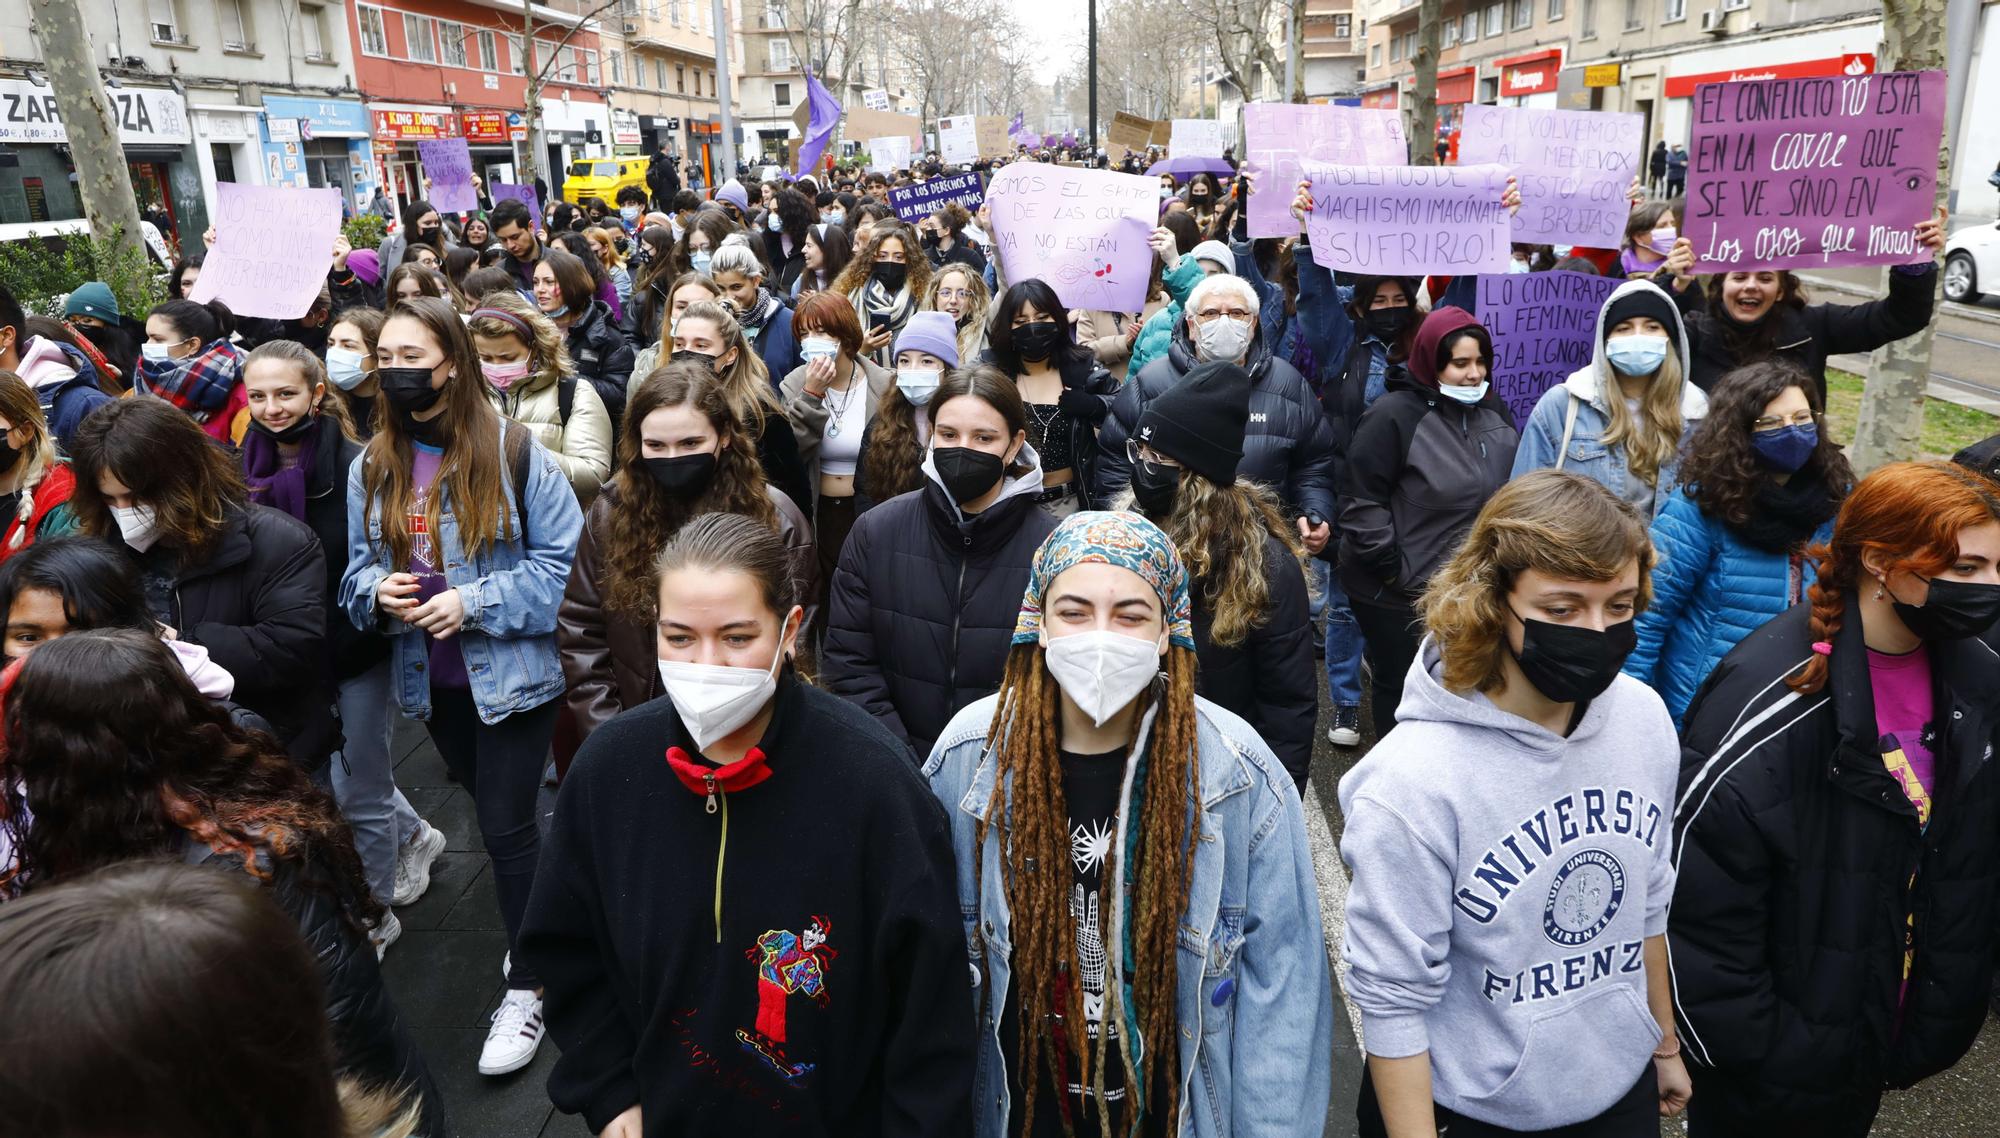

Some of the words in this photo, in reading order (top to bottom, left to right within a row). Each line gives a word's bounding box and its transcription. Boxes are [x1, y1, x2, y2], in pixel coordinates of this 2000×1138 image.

[1700, 84, 1726, 124] EL
[1736, 80, 1834, 122] CONFLICTO
[388, 112, 412, 125] KING
[1480, 111, 1505, 139] SI
[1528, 114, 1631, 143] VOLVEMOS
[1497, 144, 1522, 164] AL
[1544, 145, 1632, 171] MEDIEVOX
[1697, 135, 1727, 174] EN
[1734, 134, 1755, 172] LA
[1770, 132, 1848, 172] carne
[1860, 128, 1904, 168] QUE
[895, 189, 913, 202] POR
[915, 186, 930, 198] LOS
[930, 177, 966, 195] DERECHOS
[967, 175, 977, 186] DE
[990, 176, 1047, 196] SOMOS
[1060, 181, 1089, 197] EL
[1103, 183, 1150, 200] GRITO
[1310, 168, 1428, 187] HABLEMOS
[1435, 168, 1467, 188] DE
[1520, 175, 1583, 199] ESTOY
[1591, 181, 1626, 203] CON
[900, 207, 913, 219] LAS
[915, 198, 946, 216] MUJERES
[956, 190, 983, 208] NIÑAS
[1013, 201, 1040, 221] DE
[1054, 206, 1086, 220] LAS
[1095, 206, 1131, 220] QUE
[1309, 194, 1421, 225] MACHISMO
[1426, 194, 1504, 225] IMAGÍNATE
[1697, 179, 1729, 218] SE
[1844, 176, 1880, 218] EN
[1536, 205, 1618, 236] BRUJAS
[1001, 231, 1018, 249] YA
[1035, 233, 1056, 249] NO
[1065, 232, 1117, 252] ESTÁN
[1331, 229, 1495, 266] SUFRIRLO!
[1701, 222, 1744, 263] Los
[1820, 224, 1856, 262] que
[1485, 278, 1512, 306] LO
[1522, 274, 1613, 304] CONTRARI
[1482, 312, 1507, 336] AL
[1515, 305, 1596, 333] FEMINIS
[1504, 341, 1525, 370] LA
[1532, 338, 1591, 366] IGNOR
[1250, 413, 1267, 423] HH
[1453, 788, 1662, 924] UNIVERSIT
[1566, 852, 1623, 891] UNIVERSITARI
[1545, 875, 1564, 913] STUDI
[1482, 941, 1643, 1004] FIRENZ
